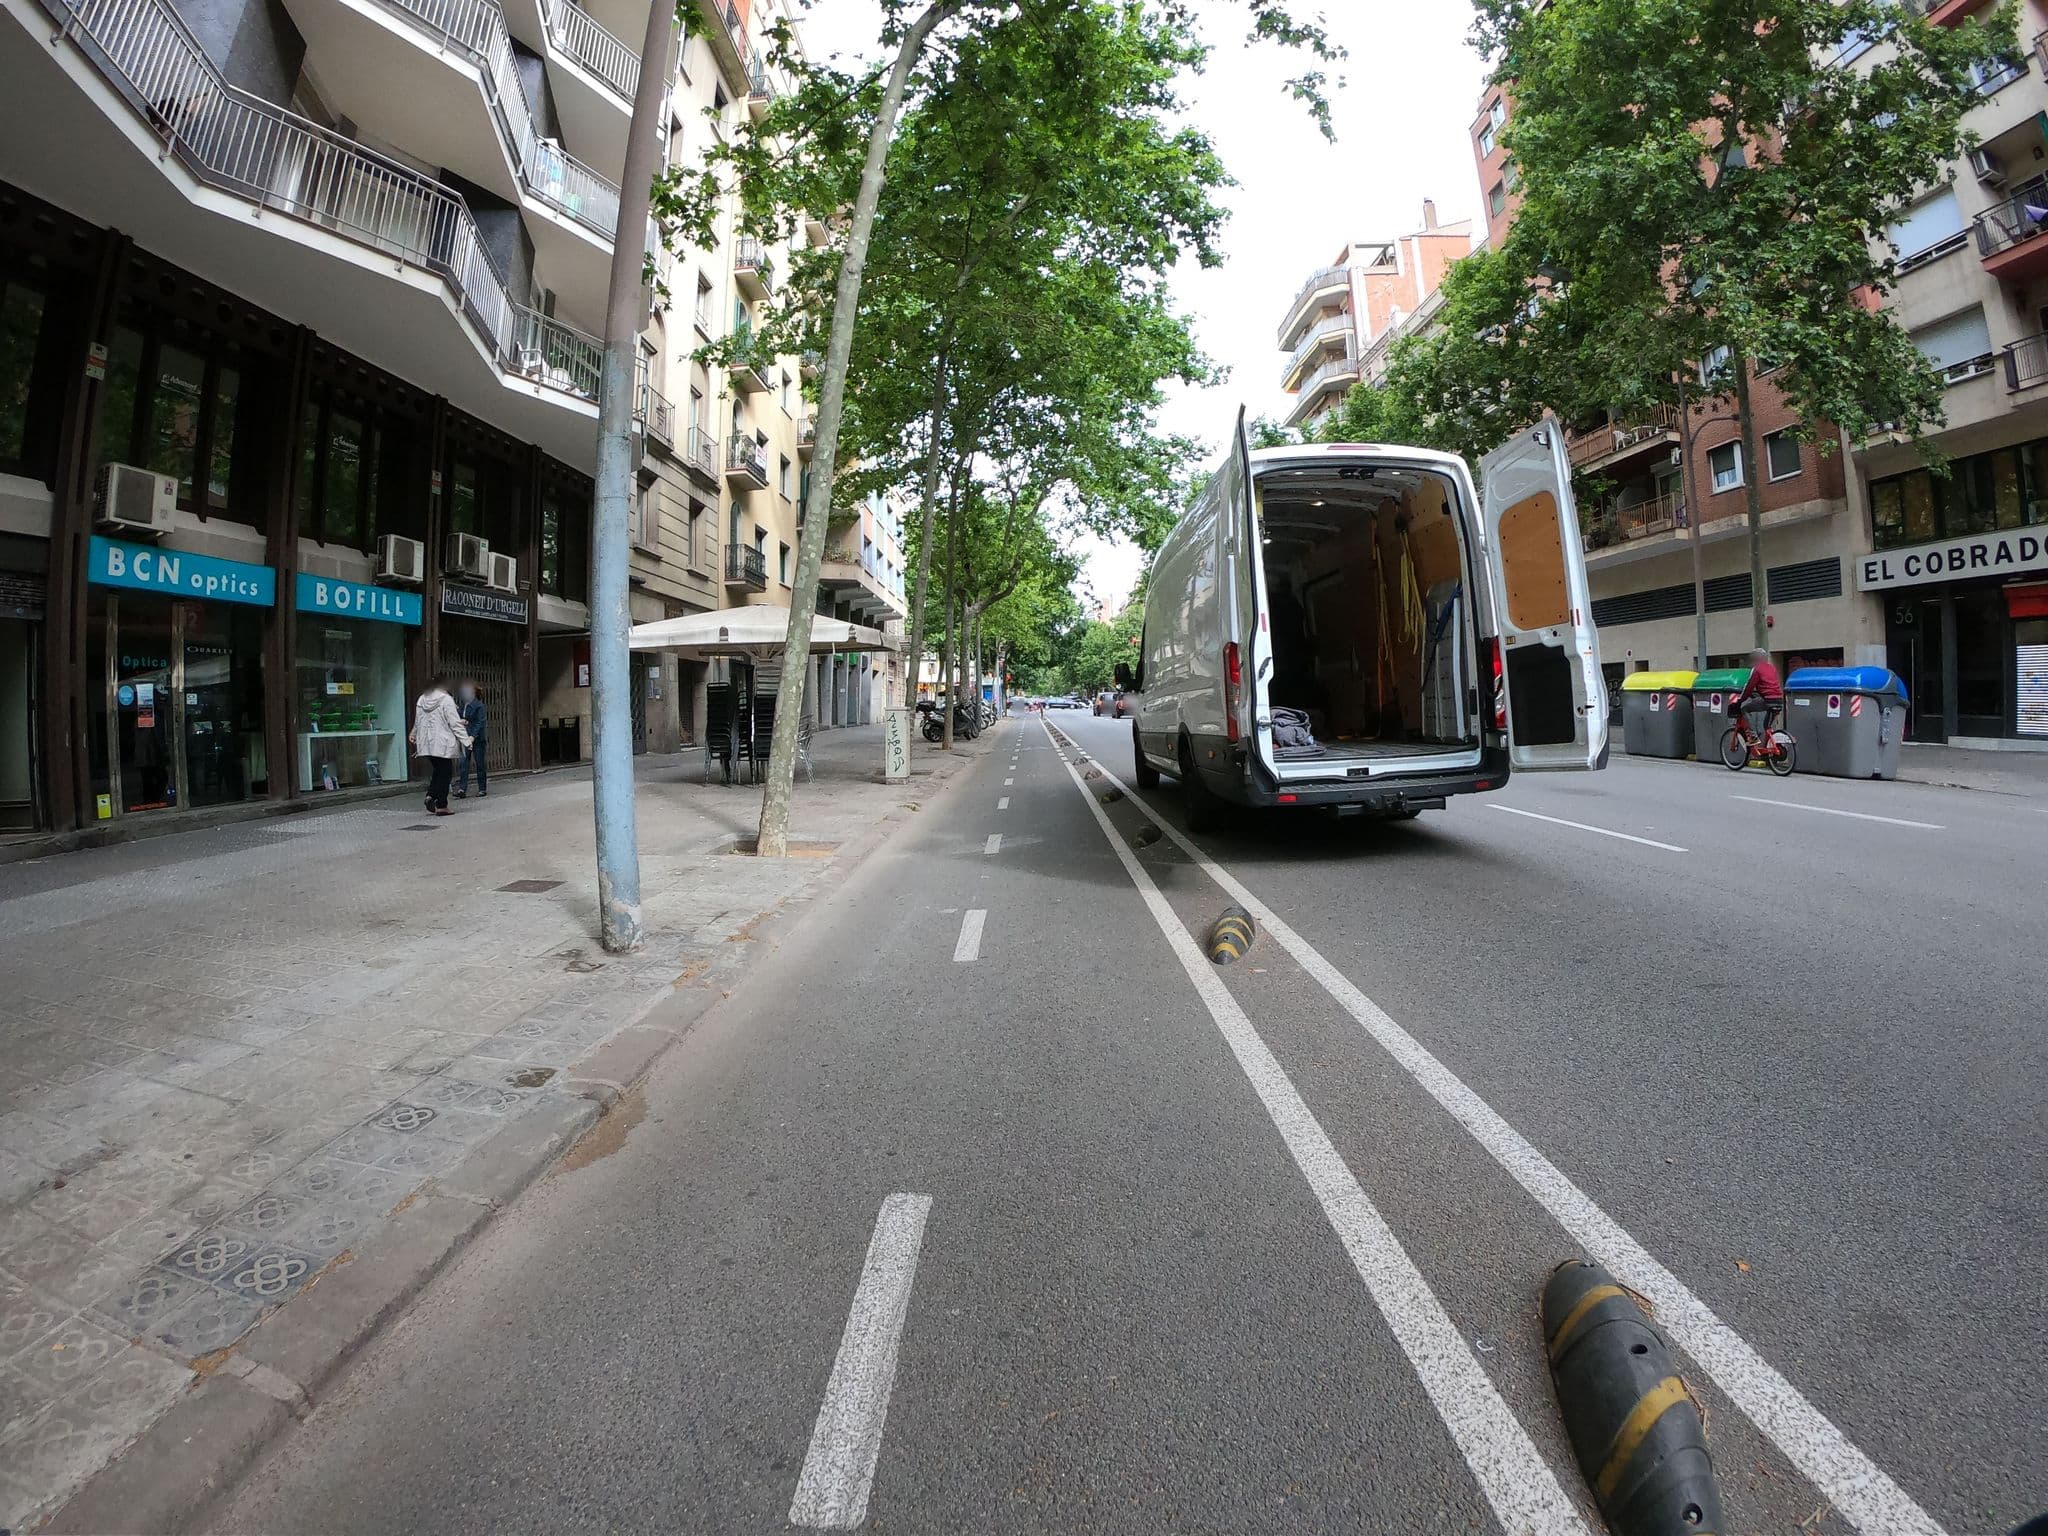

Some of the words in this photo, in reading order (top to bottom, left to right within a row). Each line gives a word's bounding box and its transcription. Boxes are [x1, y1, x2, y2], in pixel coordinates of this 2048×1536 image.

[108, 547, 180, 585] BCN
[190, 574, 258, 596] optics
[1865, 561, 1894, 583] EL
[316, 582, 404, 617] BOFILL
[445, 589, 486, 610] RACONET
[487, 596, 526, 616] D'URGELL
[1895, 604, 1913, 625] 56
[122, 655, 167, 669] Optica
